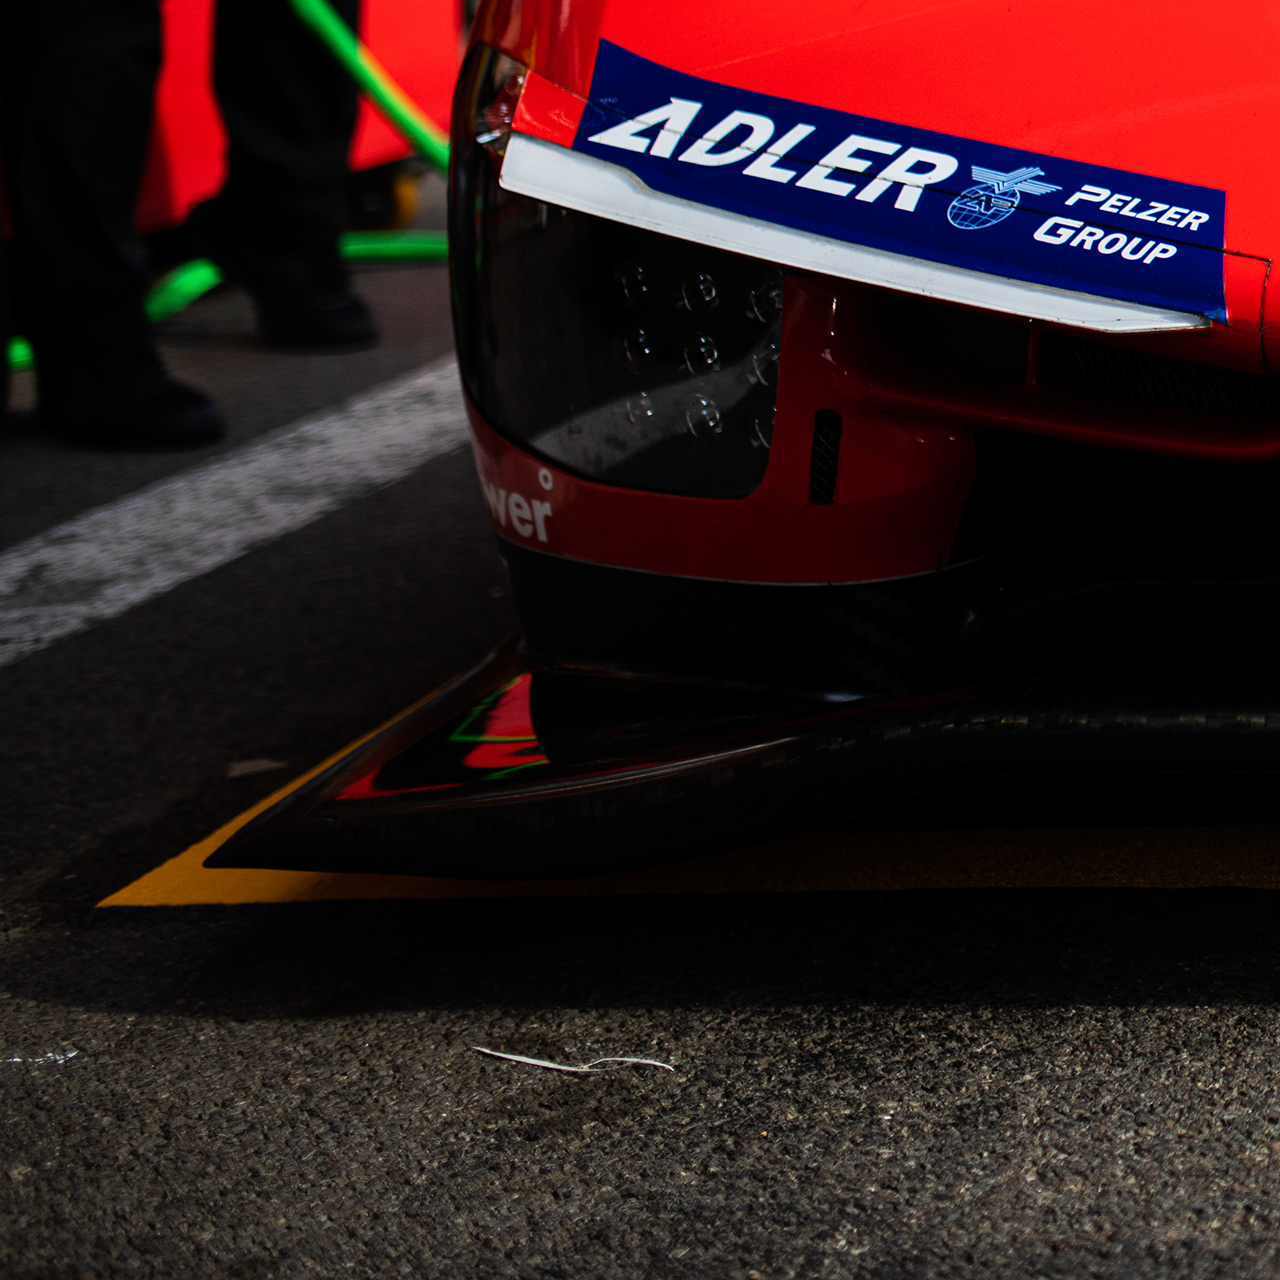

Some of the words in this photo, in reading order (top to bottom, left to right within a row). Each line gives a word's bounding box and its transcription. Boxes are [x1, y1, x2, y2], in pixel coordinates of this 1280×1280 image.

[588, 97, 959, 212] ADLER
[1064, 184, 1210, 232] PELZER
[1033, 217, 1178, 265] GROUP
